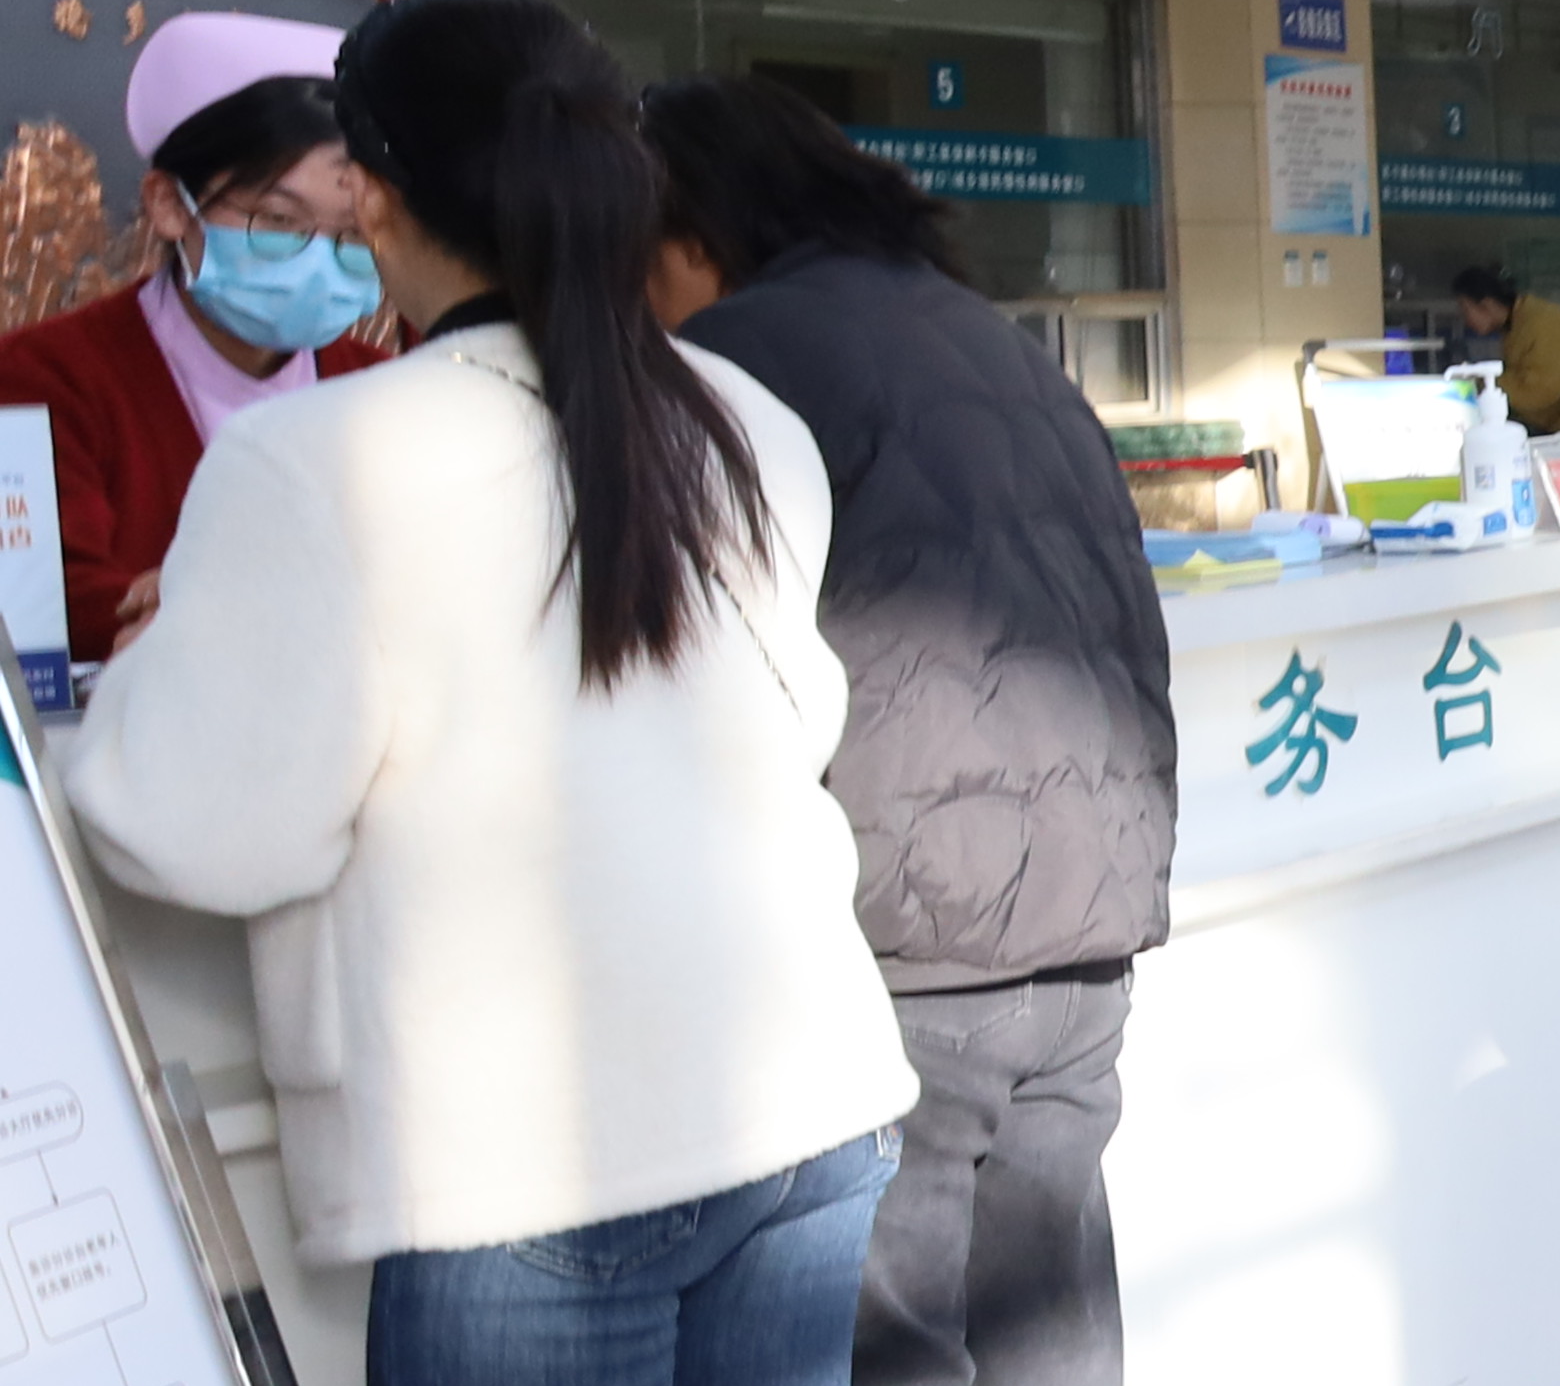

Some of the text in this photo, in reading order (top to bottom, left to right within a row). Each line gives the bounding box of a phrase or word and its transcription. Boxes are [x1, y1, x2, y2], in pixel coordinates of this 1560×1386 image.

[937, 67, 954, 102] 5
[1449, 106, 1461, 135] 3
[1245, 620, 1502, 796] 务台
